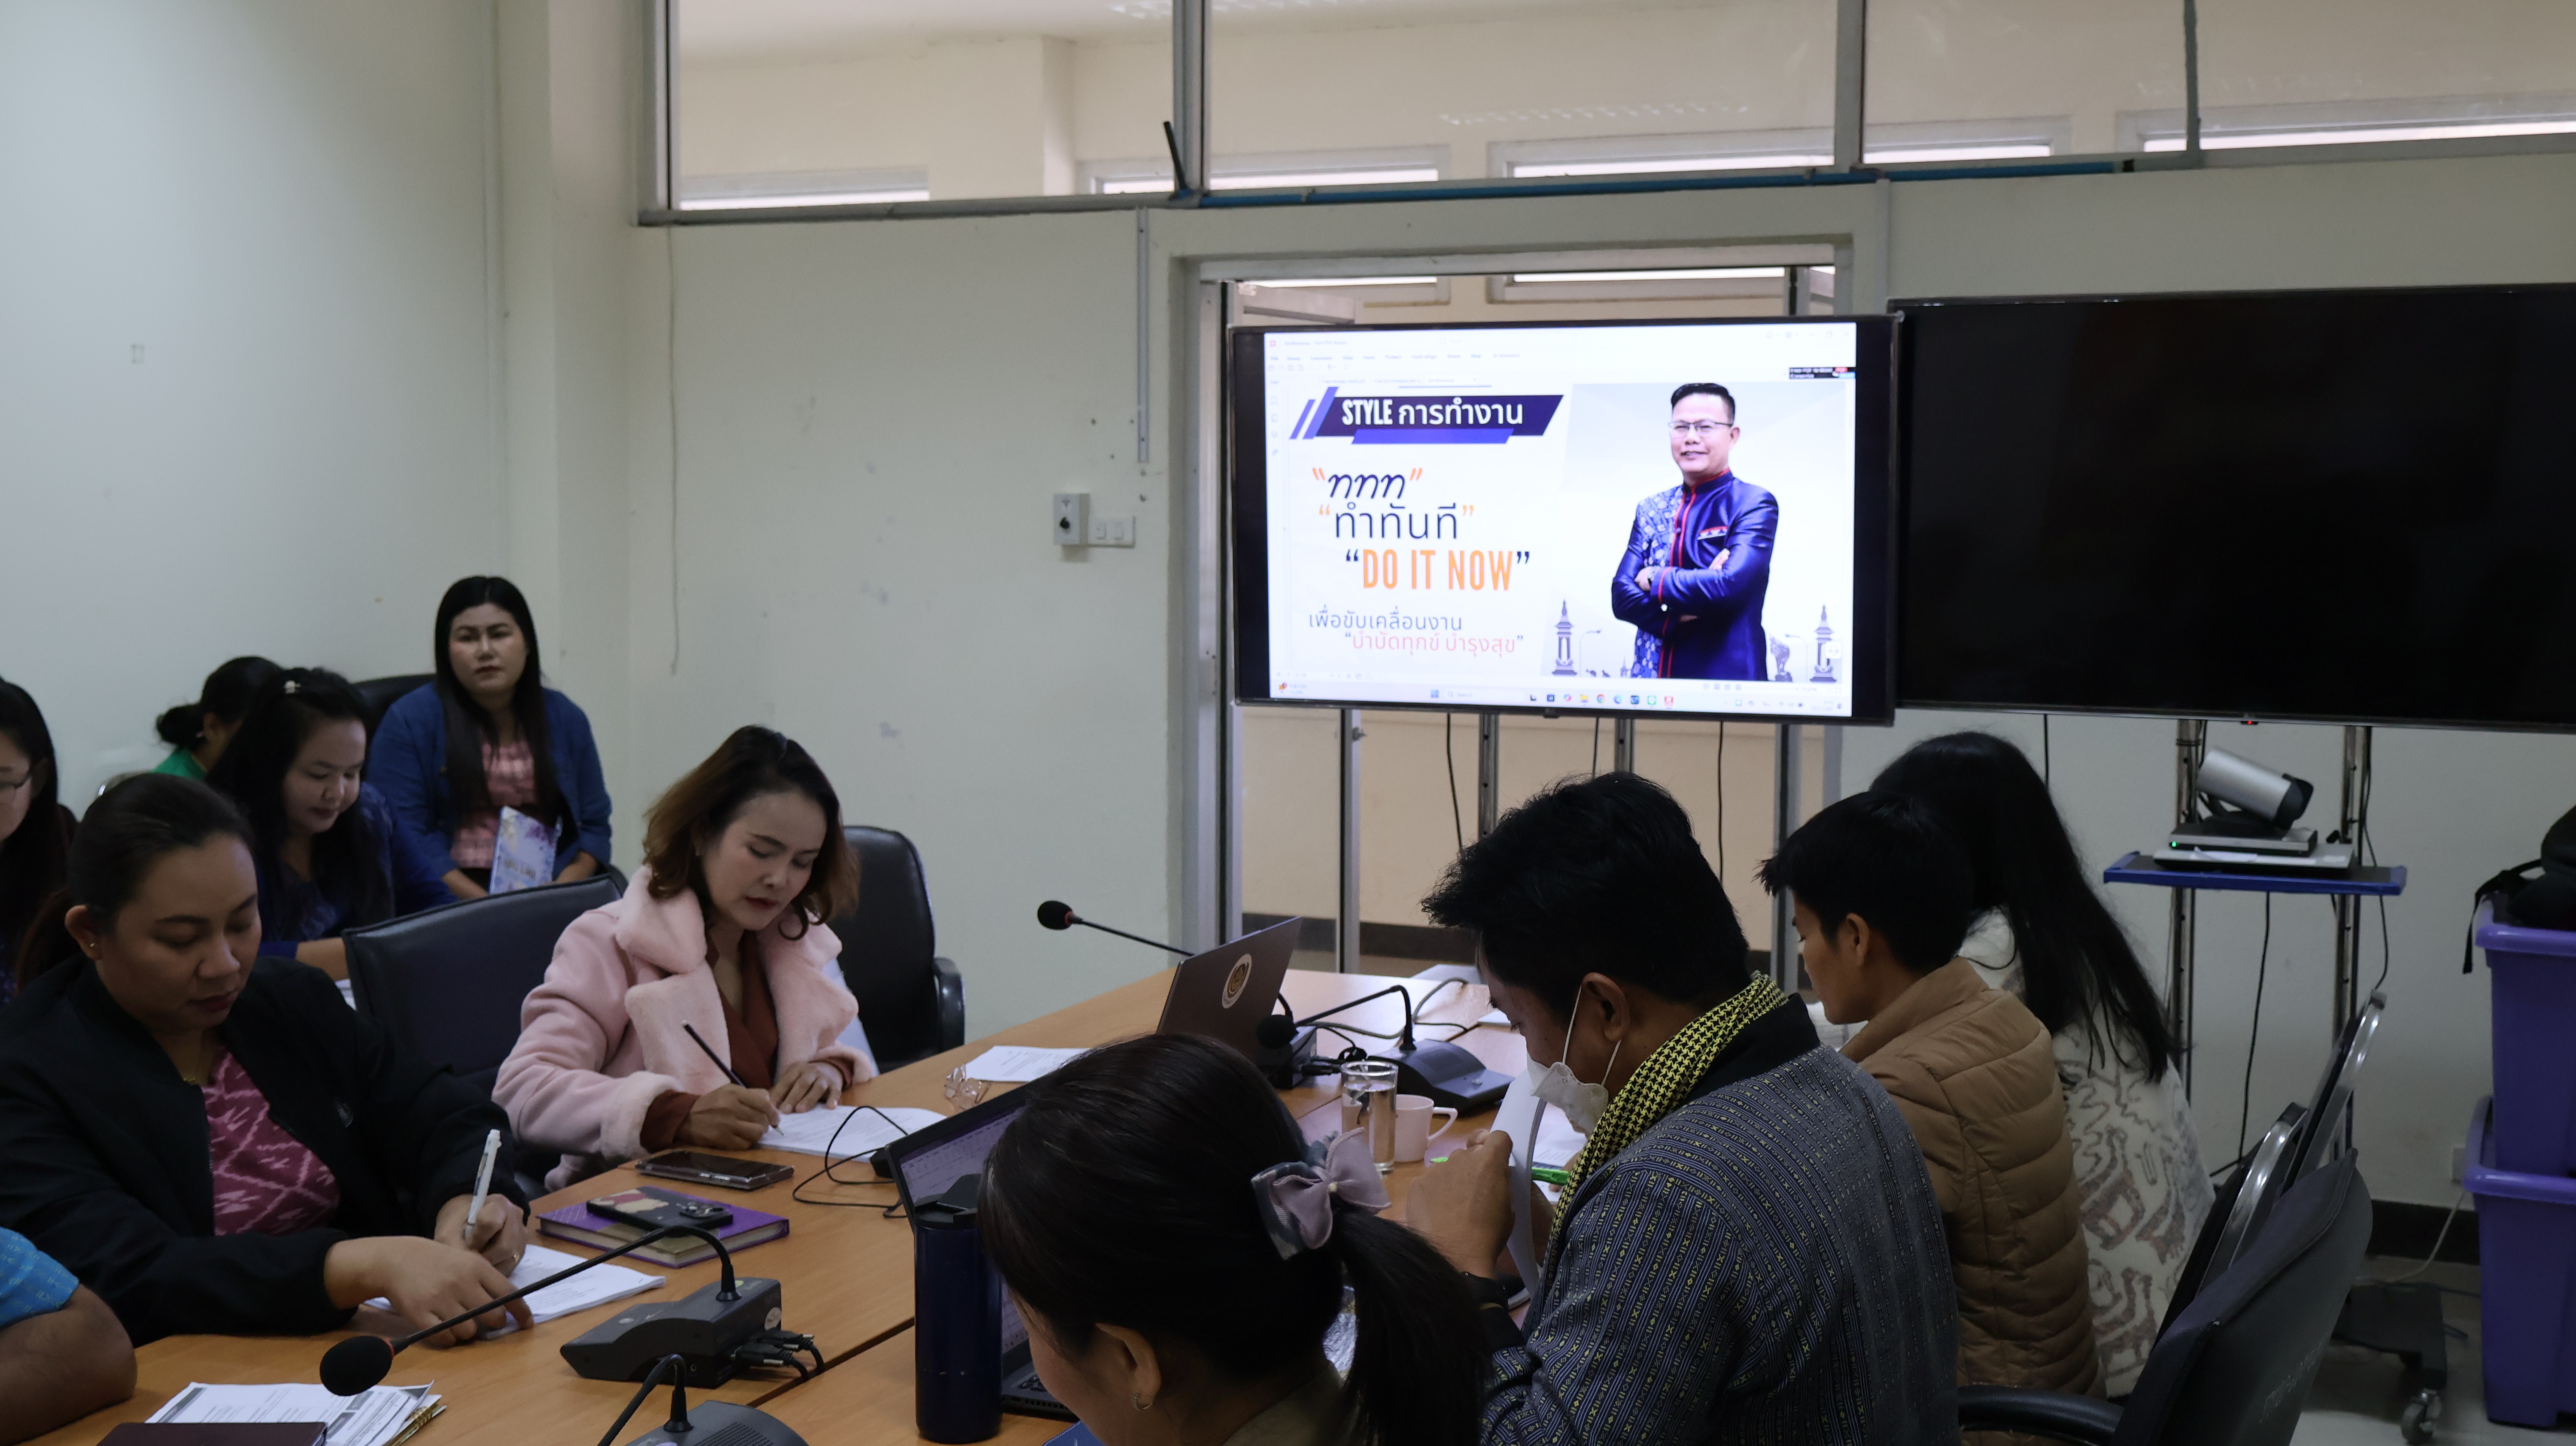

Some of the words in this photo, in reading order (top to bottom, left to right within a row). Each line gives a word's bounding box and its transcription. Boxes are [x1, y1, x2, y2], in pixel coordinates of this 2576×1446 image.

[1342, 399, 1393, 425] STYLE
[1398, 397, 1523, 425] การทำงาน
[1411, 550, 1435, 589] IT
[1309, 604, 1461, 630] เพื่อขับเคลื่อนงาน
